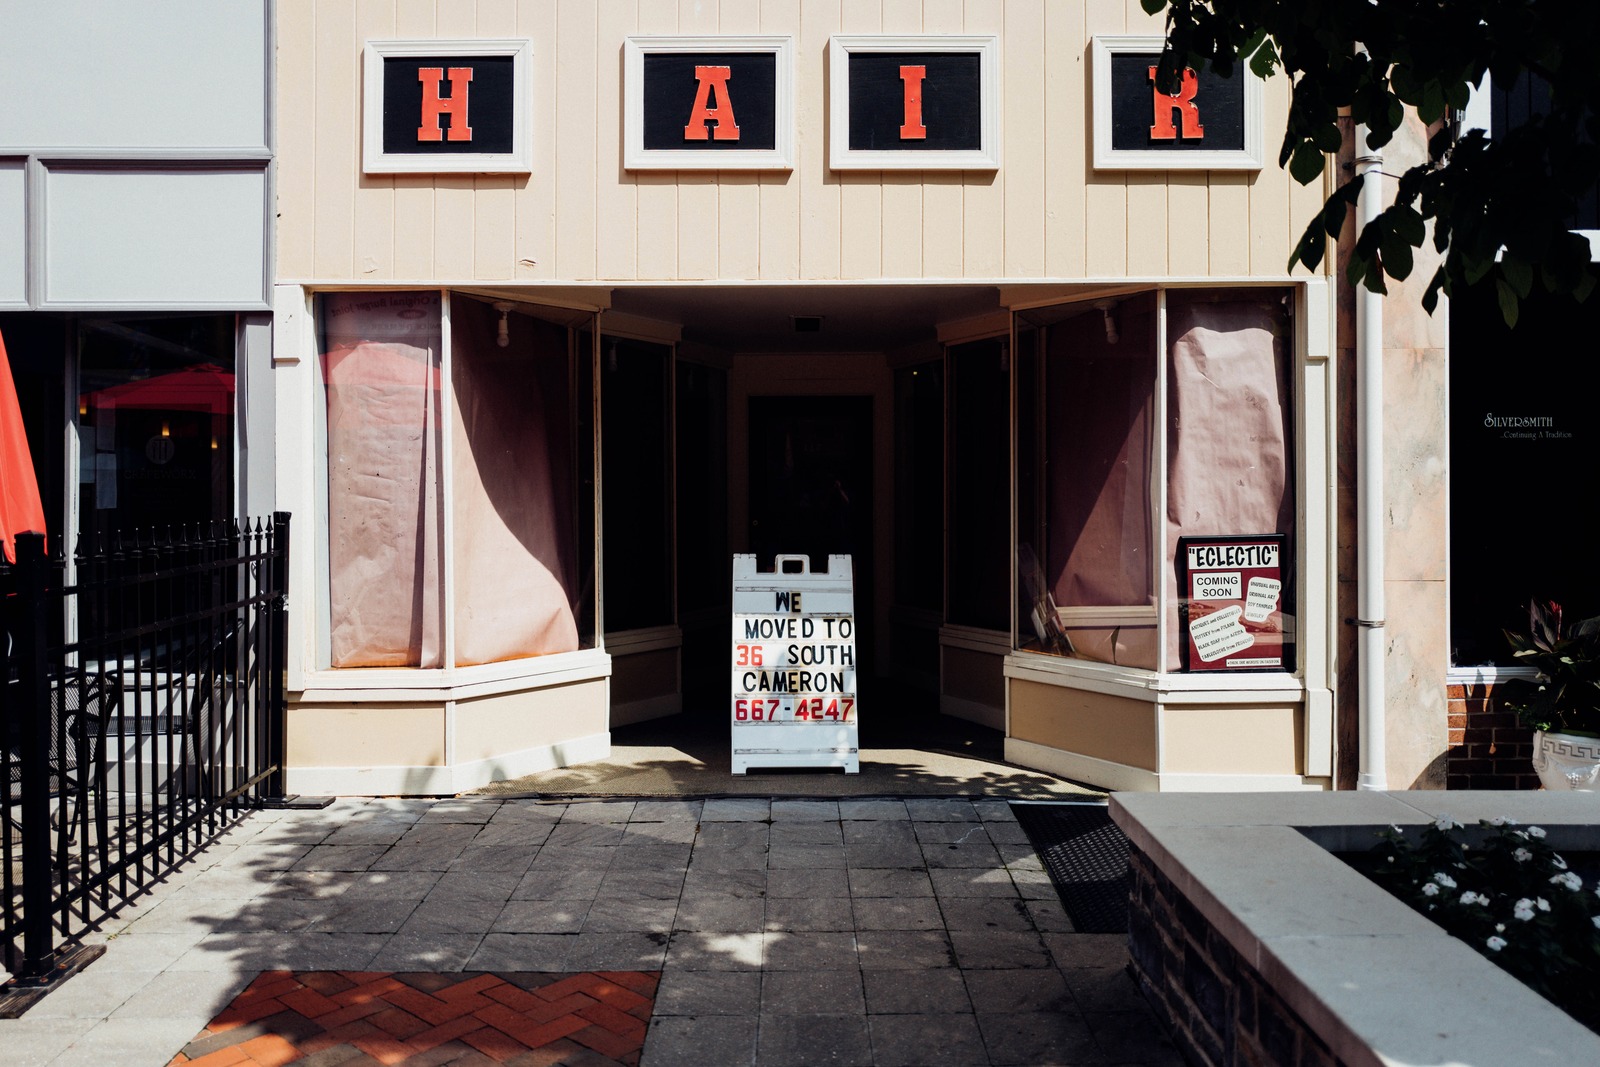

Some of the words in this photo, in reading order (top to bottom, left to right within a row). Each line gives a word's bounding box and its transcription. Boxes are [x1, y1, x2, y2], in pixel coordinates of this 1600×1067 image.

[1188, 546, 1278, 567] "ECLECTIC"
[1196, 576, 1238, 586] COMING
[775, 592, 802, 613] WE
[1202, 588, 1232, 597] SOON
[744, 618, 815, 639] MOVED
[822, 618, 852, 638] TO
[736, 645, 763, 666] 36
[787, 644, 853, 666] SOUTH
[742, 671, 845, 693] CAMERON
[735, 699, 854, 721] 667-4247
